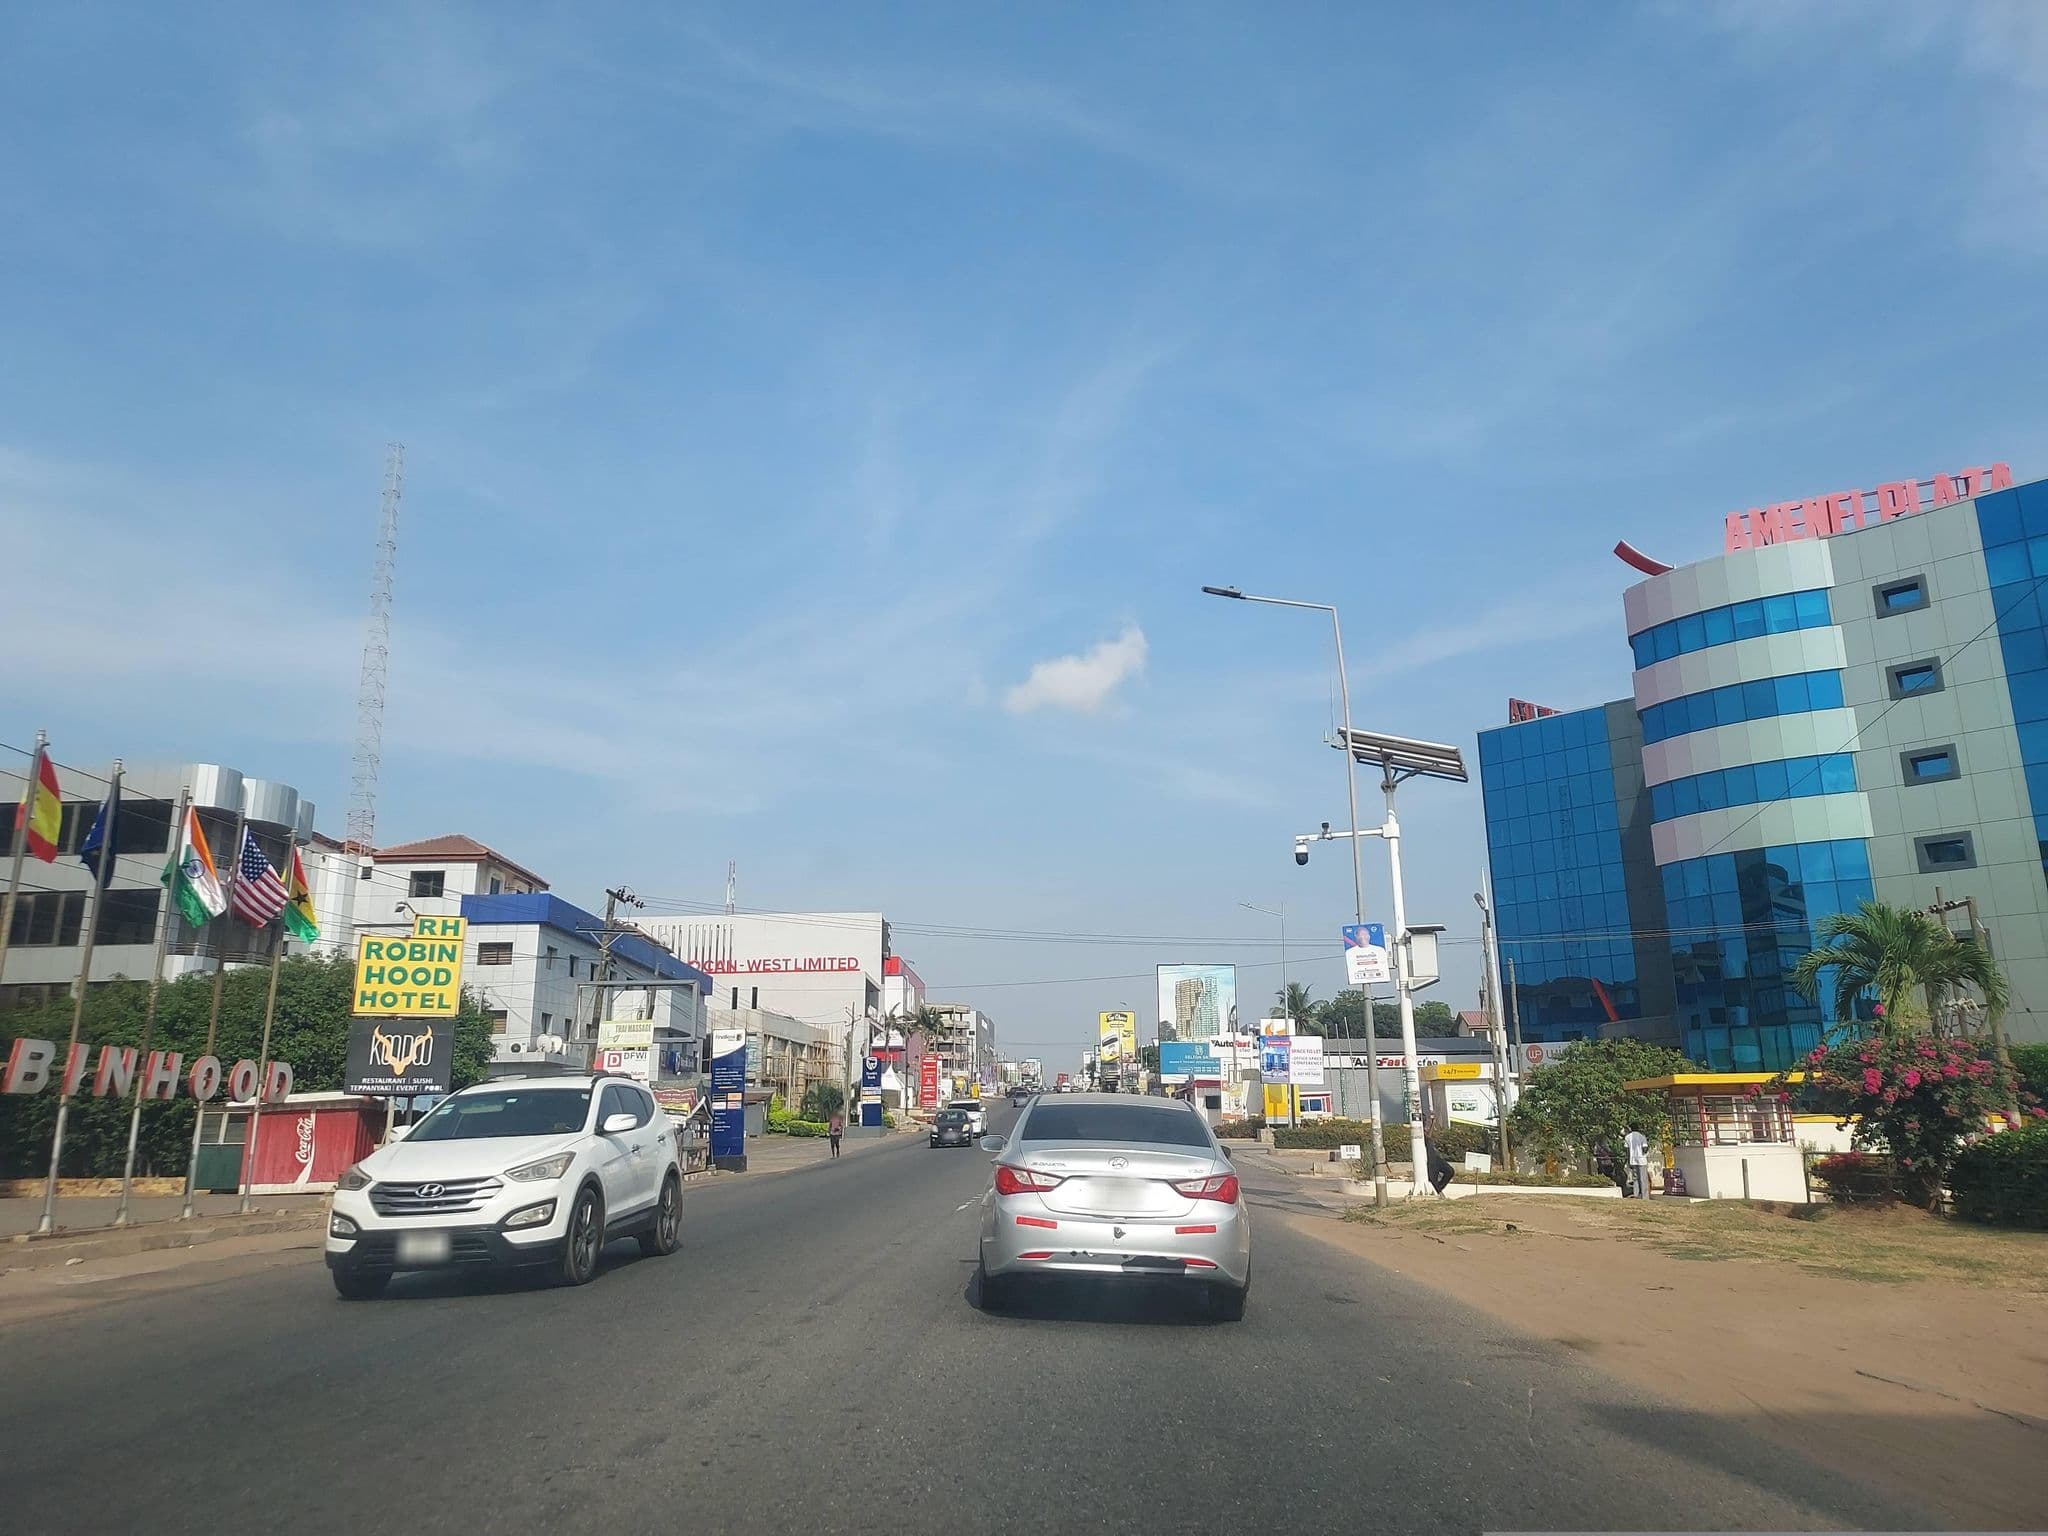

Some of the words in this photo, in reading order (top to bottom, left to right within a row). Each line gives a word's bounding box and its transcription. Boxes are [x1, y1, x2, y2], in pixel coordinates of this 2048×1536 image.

[1724, 487, 1864, 554] AMENFI
[1877, 461, 2014, 521] PLAZA
[418, 918, 461, 937] RH
[365, 941, 457, 963] ROBIN
[794, 957, 859, 971] LIMITED
[364, 965, 452, 987] HOOD
[359, 990, 452, 1010] HOTEL
[295, 1117, 313, 1163] Coca-Cola
